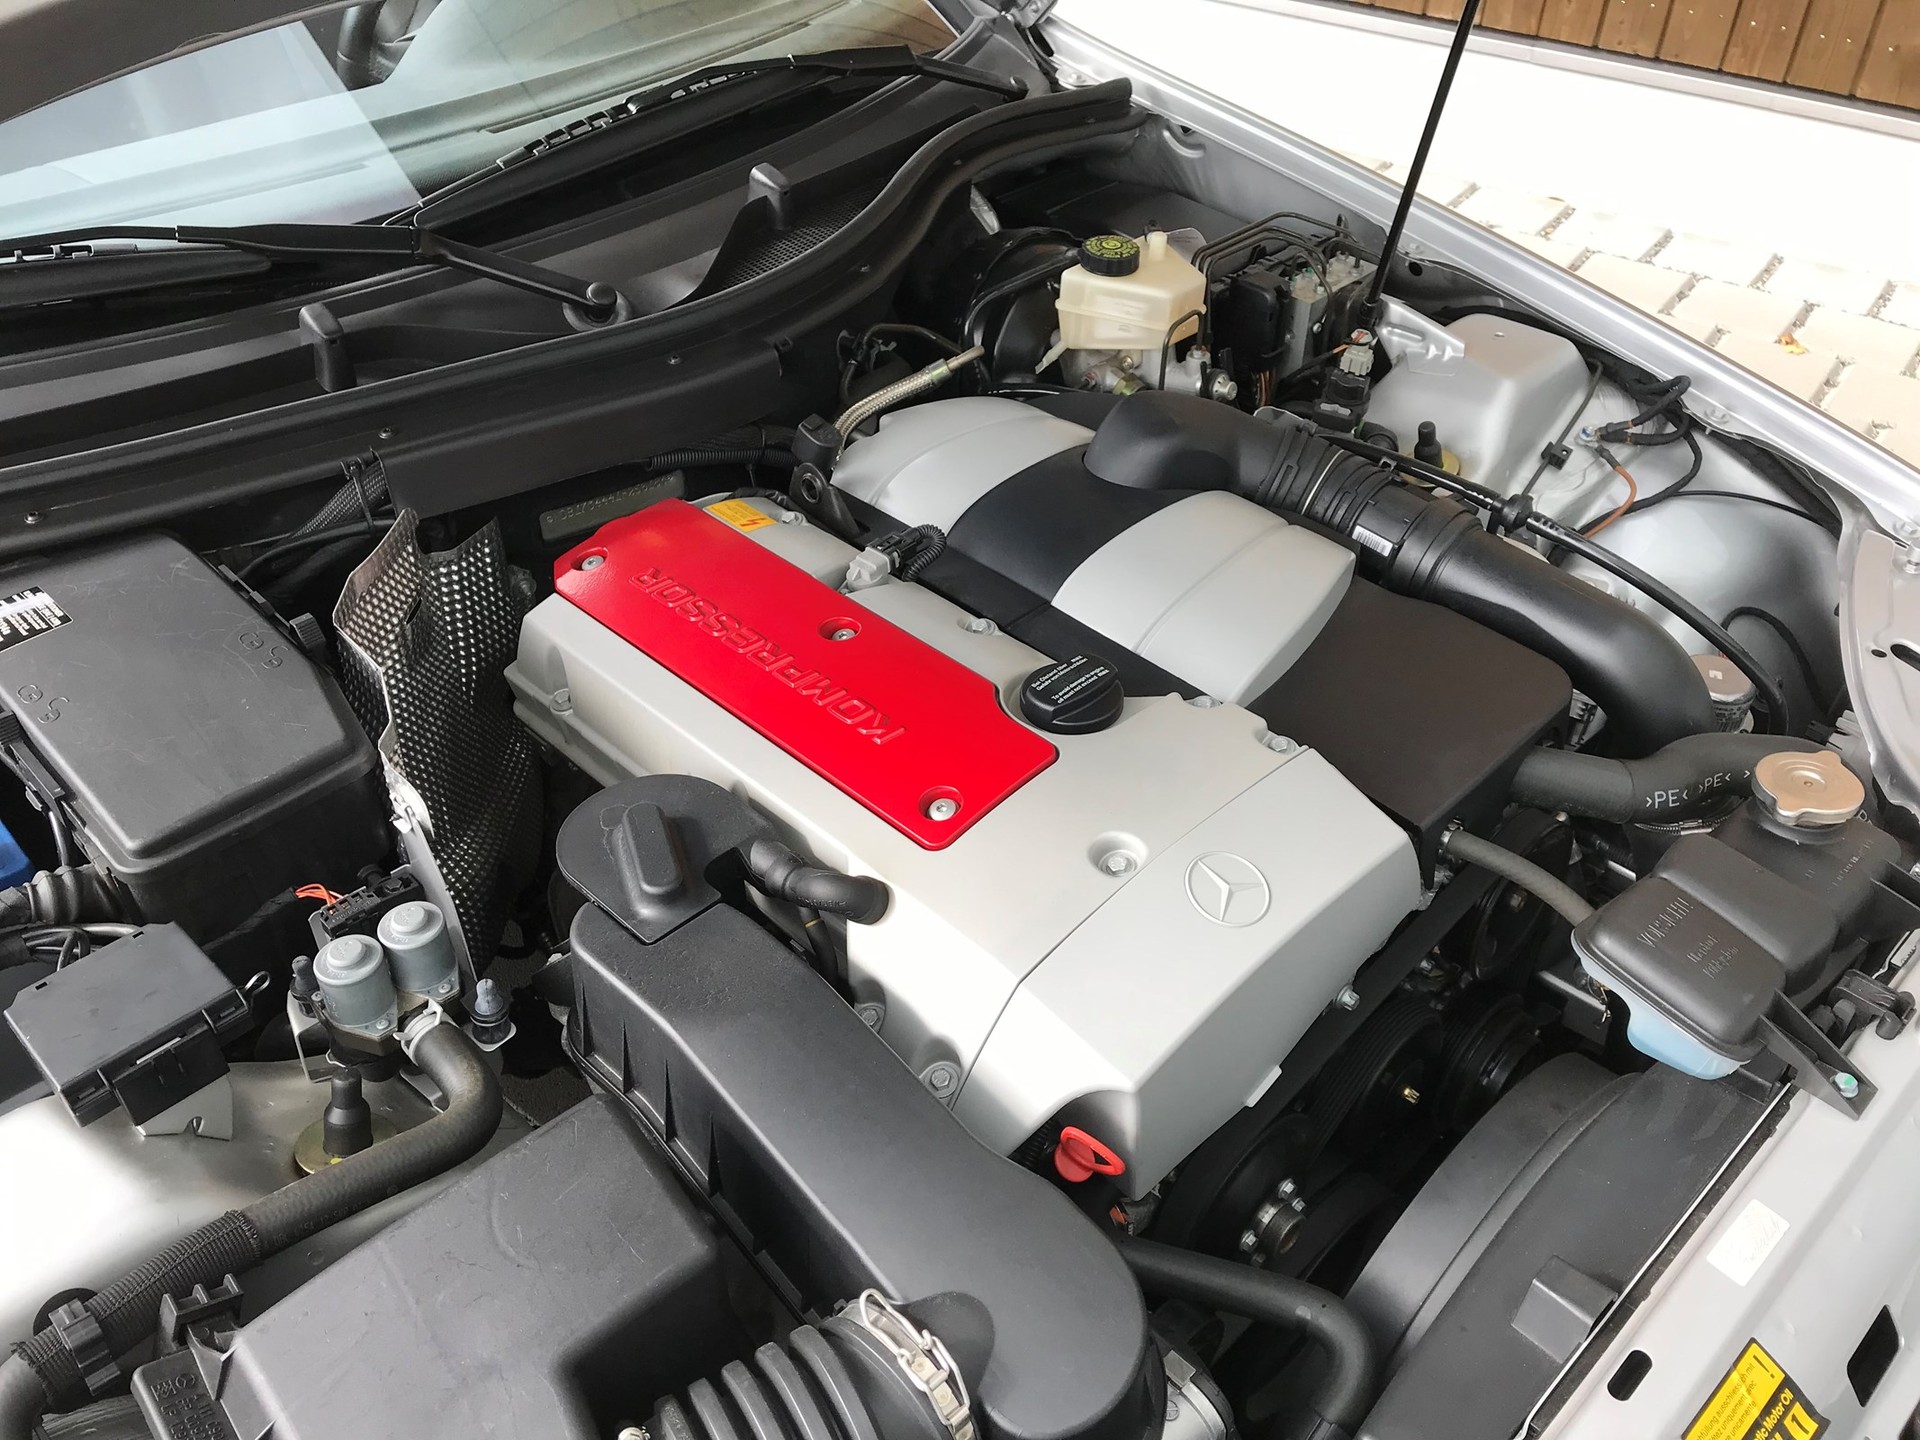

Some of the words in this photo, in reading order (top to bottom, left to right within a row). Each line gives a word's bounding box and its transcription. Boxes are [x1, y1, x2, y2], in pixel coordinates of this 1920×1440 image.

[629, 567, 907, 746] KOMPRESSOR
[1058, 686, 1071, 696] avoid
[1069, 676, 1087, 688] damage
[1063, 689, 1075, 699] must
[1081, 675, 1098, 687] exceed
[1762, 1401, 1786, 1432] Motor
[1780, 1387, 1794, 1406] Oil
[1790, 1413, 1811, 1435] 1
